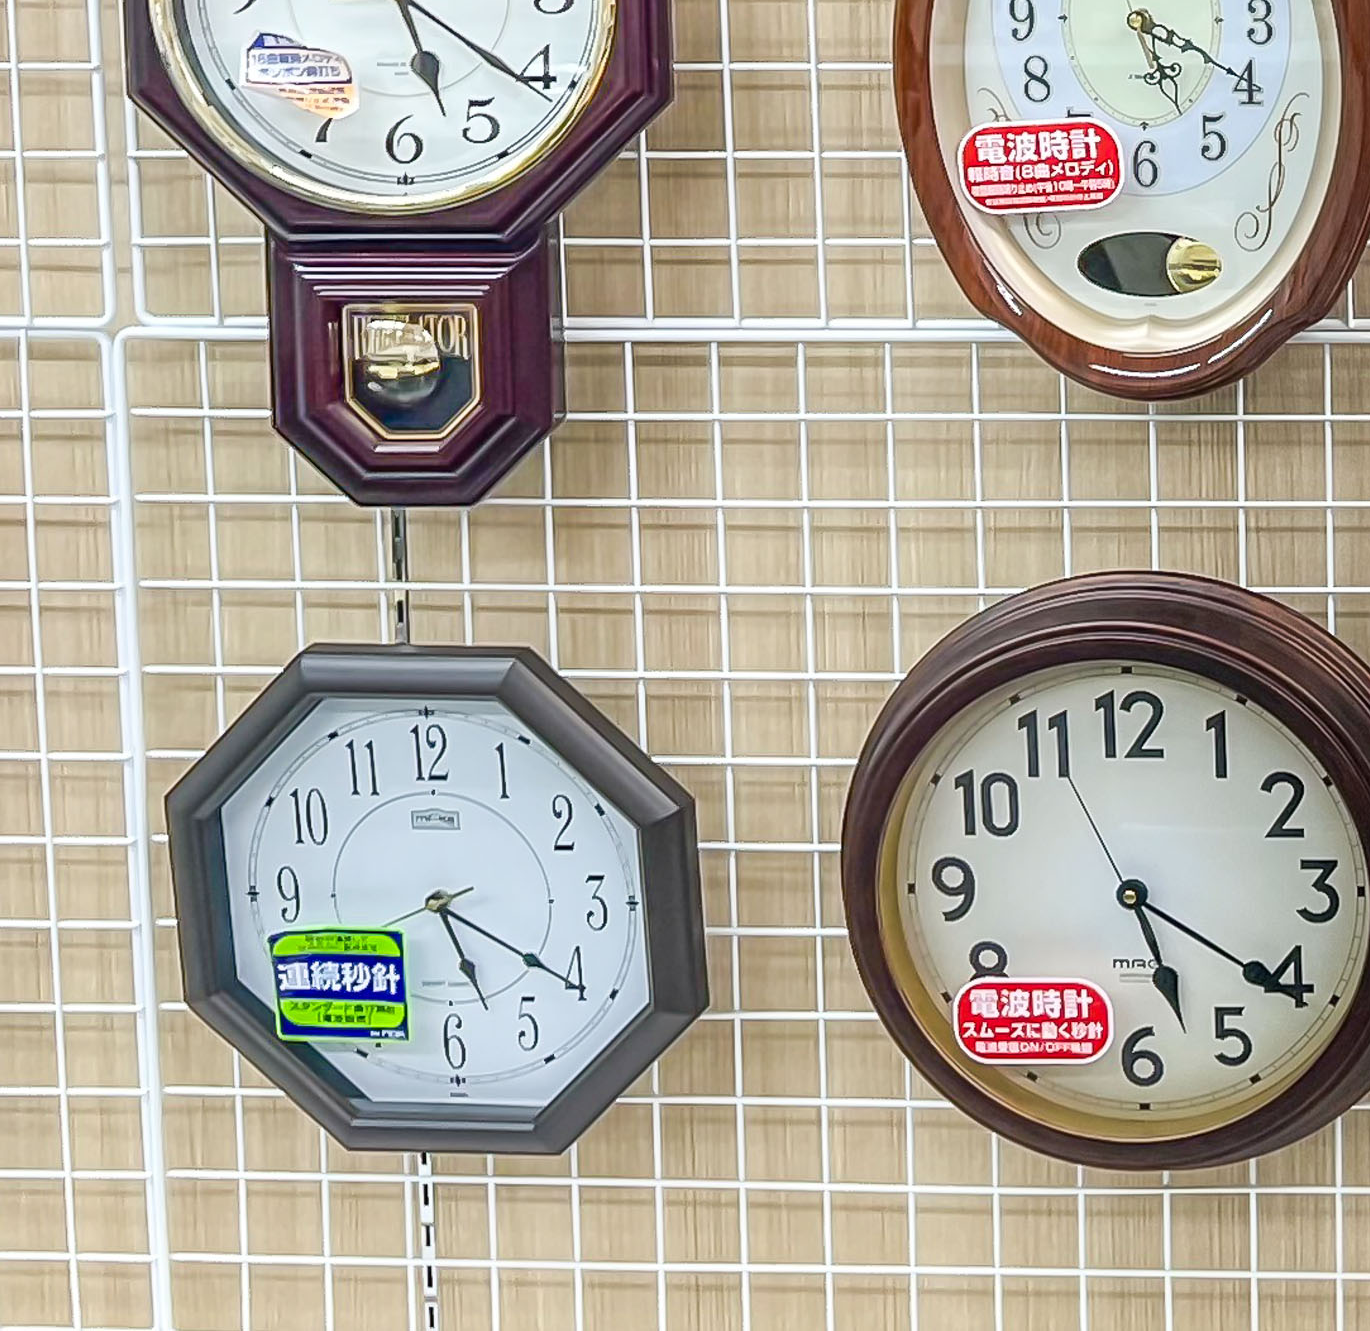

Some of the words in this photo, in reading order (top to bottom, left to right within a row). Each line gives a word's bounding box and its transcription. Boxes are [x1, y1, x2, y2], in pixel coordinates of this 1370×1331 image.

[386, 116, 423, 164] 6
[975, 128, 1100, 164] 電波時計
[1202, 115, 1226, 160] 5
[1095, 690, 1164, 758] 12
[410, 725, 448, 780] 12
[290, 789, 327, 845] 10
[553, 795, 574, 850] 2
[955, 769, 1018, 836] 10
[277, 867, 300, 922] 9
[1297, 860, 1339, 923] 3
[277, 961, 400, 995] 連続秒針
[970, 989, 1093, 1019] 電波時計
[962, 1022, 1103, 1039] スムーズに動く秒針
[1215, 1007, 1252, 1066] 5
